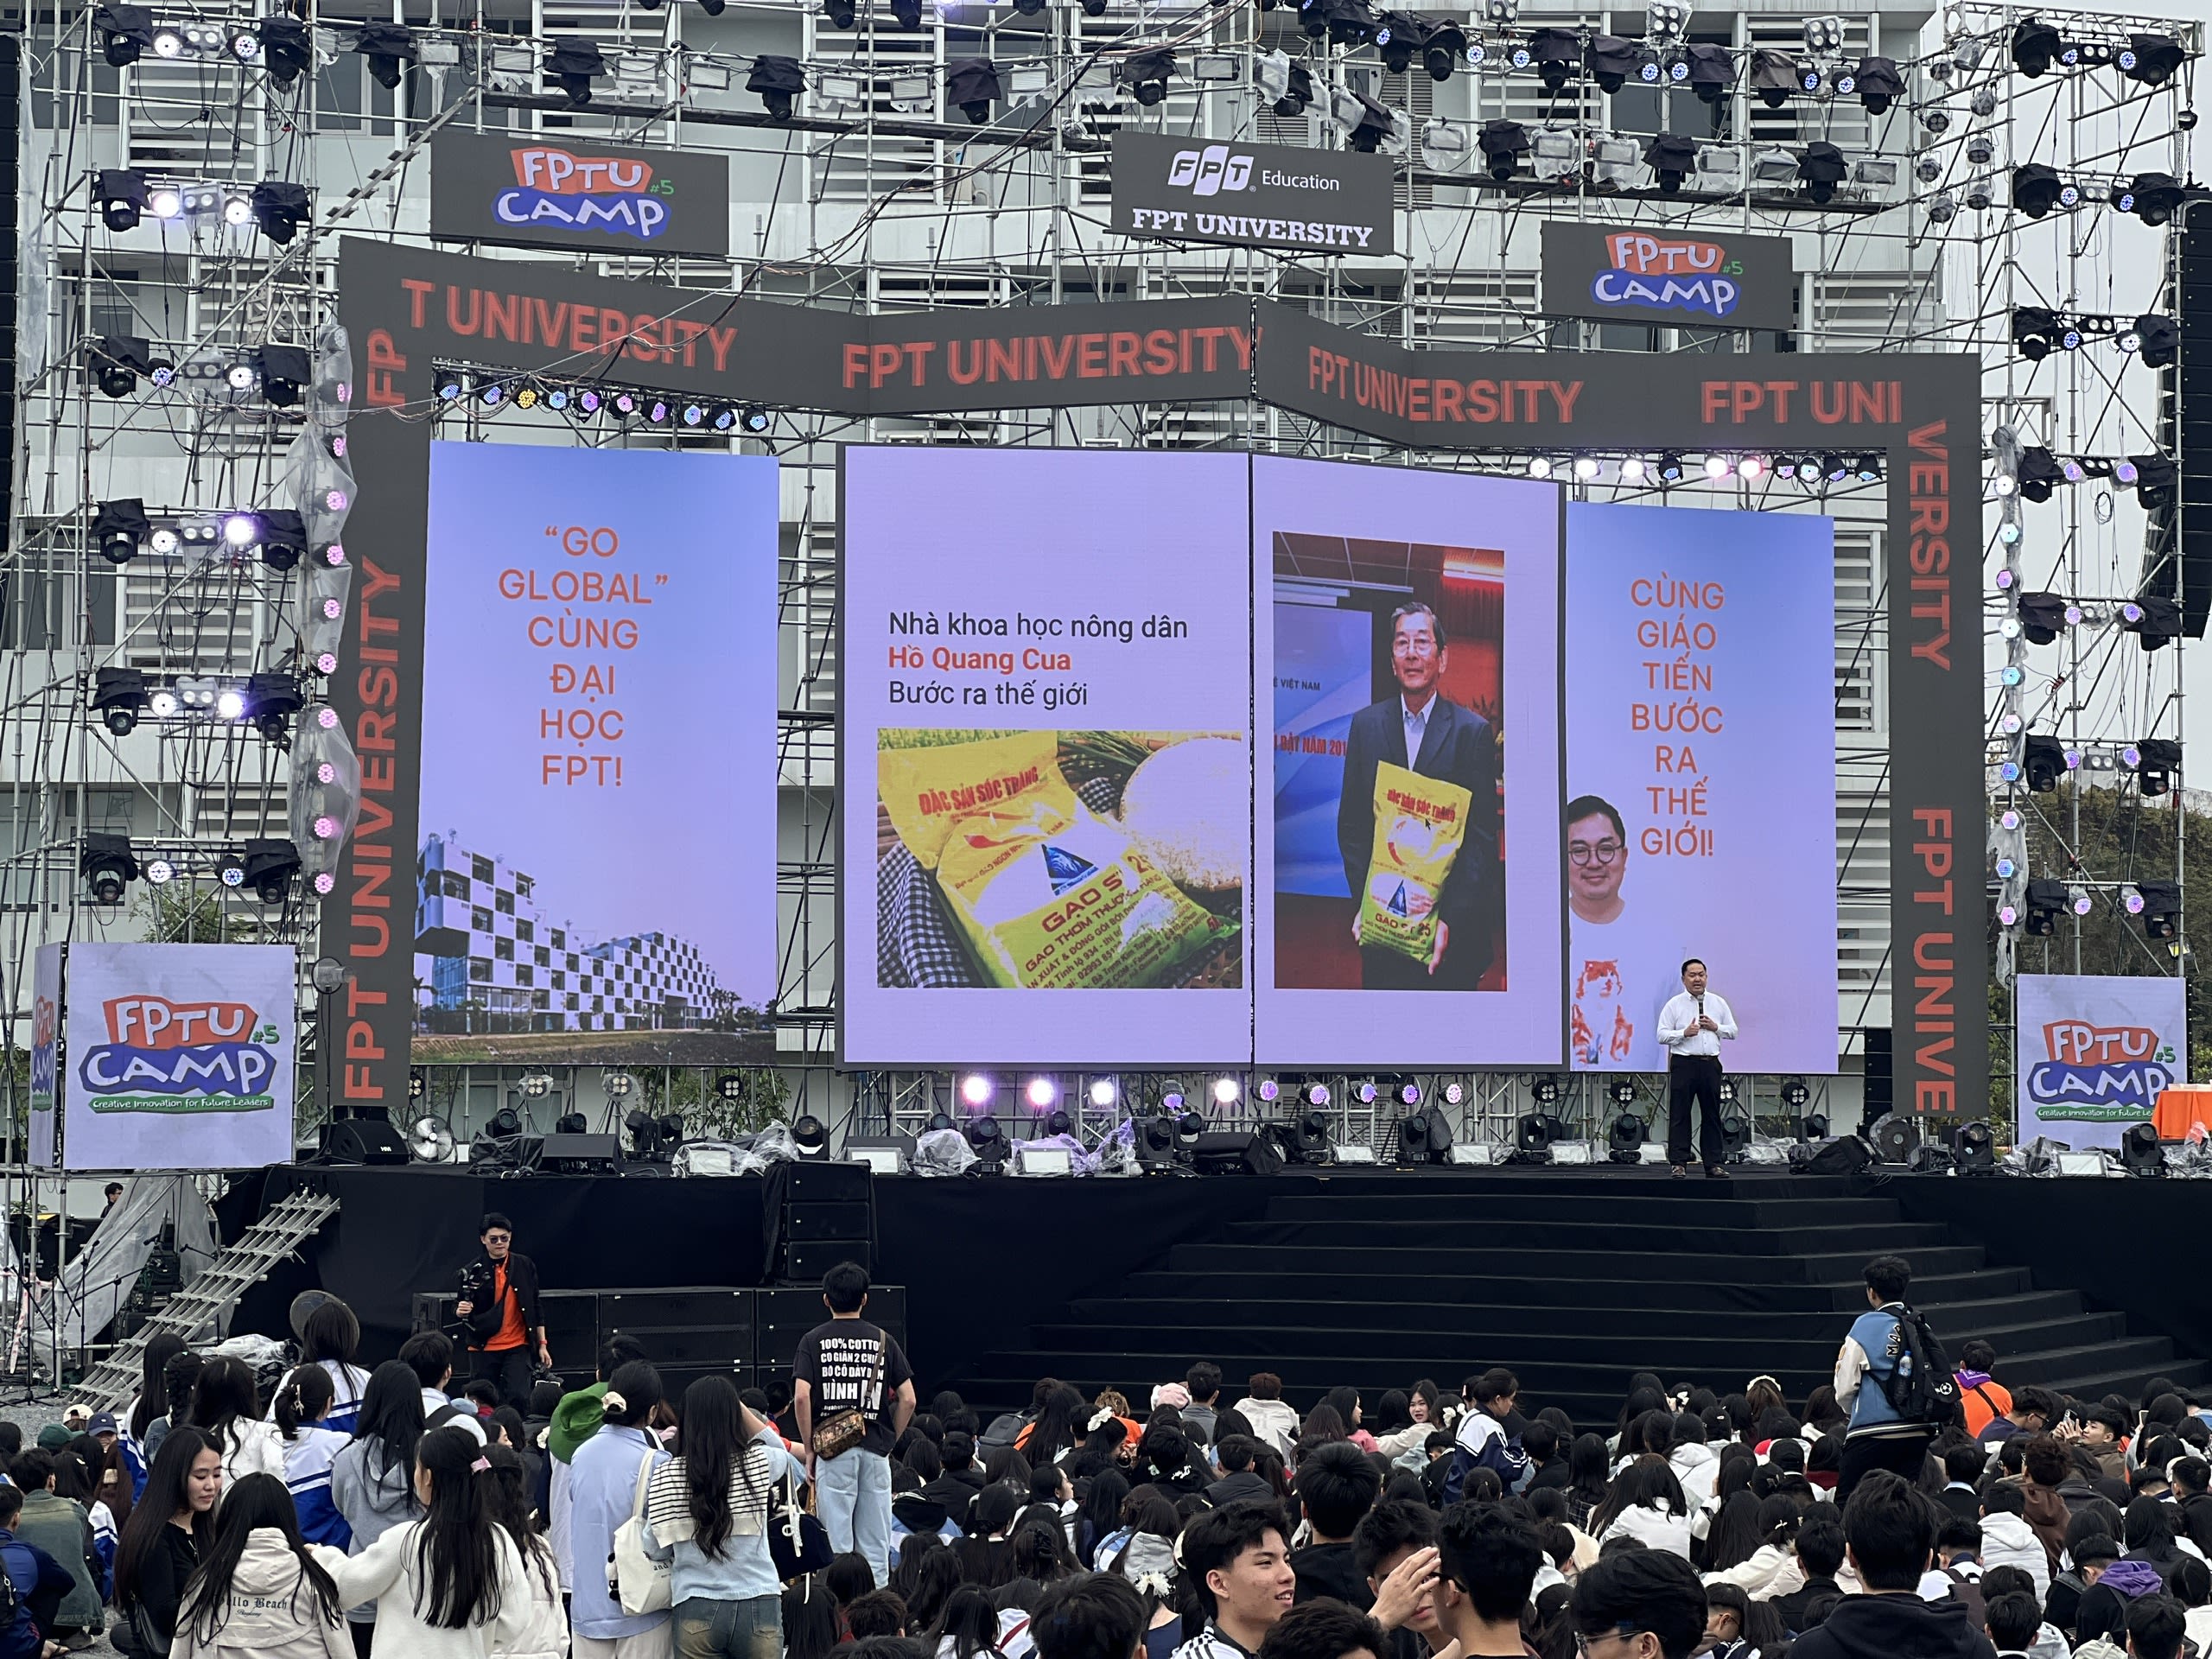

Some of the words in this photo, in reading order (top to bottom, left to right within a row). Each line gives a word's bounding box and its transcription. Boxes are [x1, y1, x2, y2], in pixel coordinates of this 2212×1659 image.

[523, 150, 643, 191] FPTU
[650, 179, 676, 196] #5
[1167, 145, 1255, 196] FPT
[1262, 170, 1340, 191] Education
[496, 191, 664, 236] CAMP
[1132, 207, 1188, 232] FPT
[1195, 213, 1374, 247] UNIVERSITY
[1613, 234, 1718, 271] FPTU
[1723, 260, 1745, 276] #5
[1593, 274, 1737, 314] CAMP
[446, 284, 739, 372] UNIVERSITY
[842, 341, 937, 389] FPT
[947, 325, 1263, 386] UNIVERSITY
[1307, 345, 1350, 400] FPT
[1353, 359, 1585, 424] UNIVERSITY
[1700, 380, 1799, 425] FPT
[1808, 380, 1902, 425] UNI
[1907, 419, 1952, 672] VERSITY
[1630, 570, 1725, 611] CÙNG
[527, 607, 639, 651] CÙNG
[889, 611, 939, 635] Nhà
[948, 612, 1007, 636] khoa
[1017, 612, 1063, 640] học
[1071, 613, 1134, 644] nông
[1141, 614, 1188, 639] dân
[1637, 613, 1717, 651] GIÁO
[888, 644, 925, 669] Hồ
[932, 646, 1014, 676] Quang
[1022, 648, 1071, 671] Cua
[1642, 651, 1712, 692] TIẾN
[550, 663, 616, 702] ĐẠI
[889, 680, 955, 704] Bước
[963, 687, 987, 705] ra
[995, 679, 1037, 705] thế
[1042, 682, 1088, 711] giới
[1301, 680, 1321, 691] NAM
[539, 709, 625, 747] HỌC
[1631, 696, 1724, 734] BƯỚC
[350, 554, 401, 958] UNIVERSITY
[542, 754, 623, 787] FPT!
[1655, 745, 1698, 774] RA
[1646, 775, 1709, 816] THẾ
[1640, 819, 1714, 857] GIỚI!
[1912, 808, 1954, 917] FPT
[1041, 887, 1103, 933] GẠO
[115, 1000, 245, 1046] FPTU
[251, 1024, 281, 1045] #5
[343, 974, 388, 1100] FPT
[1912, 932, 1957, 1114] UNIVE
[2052, 1025, 2150, 1064] FPTU
[86, 1050, 268, 1095] CAMP
[2032, 1067, 2167, 1106] CAMP
[92, 1099, 132, 1109] Creative
[133, 1098, 183, 1109] Innovation
[184, 1098, 199, 1108] for
[200, 1098, 232, 1108] Future
[232, 1097, 269, 1107] Leaders
[2068, 1109, 2106, 1117] Innovation
[2106, 1109, 2118, 1118] for
[819, 1338, 848, 1351] 100%
[848, 1338, 885, 1353] COTTO
[854, 1352, 861, 1363] 2
[822, 1378, 858, 1400] HÌNH
[867, 1366, 885, 1381] DN
[226, 1596, 249, 1607] llo
[254, 1596, 288, 1610] Beach
